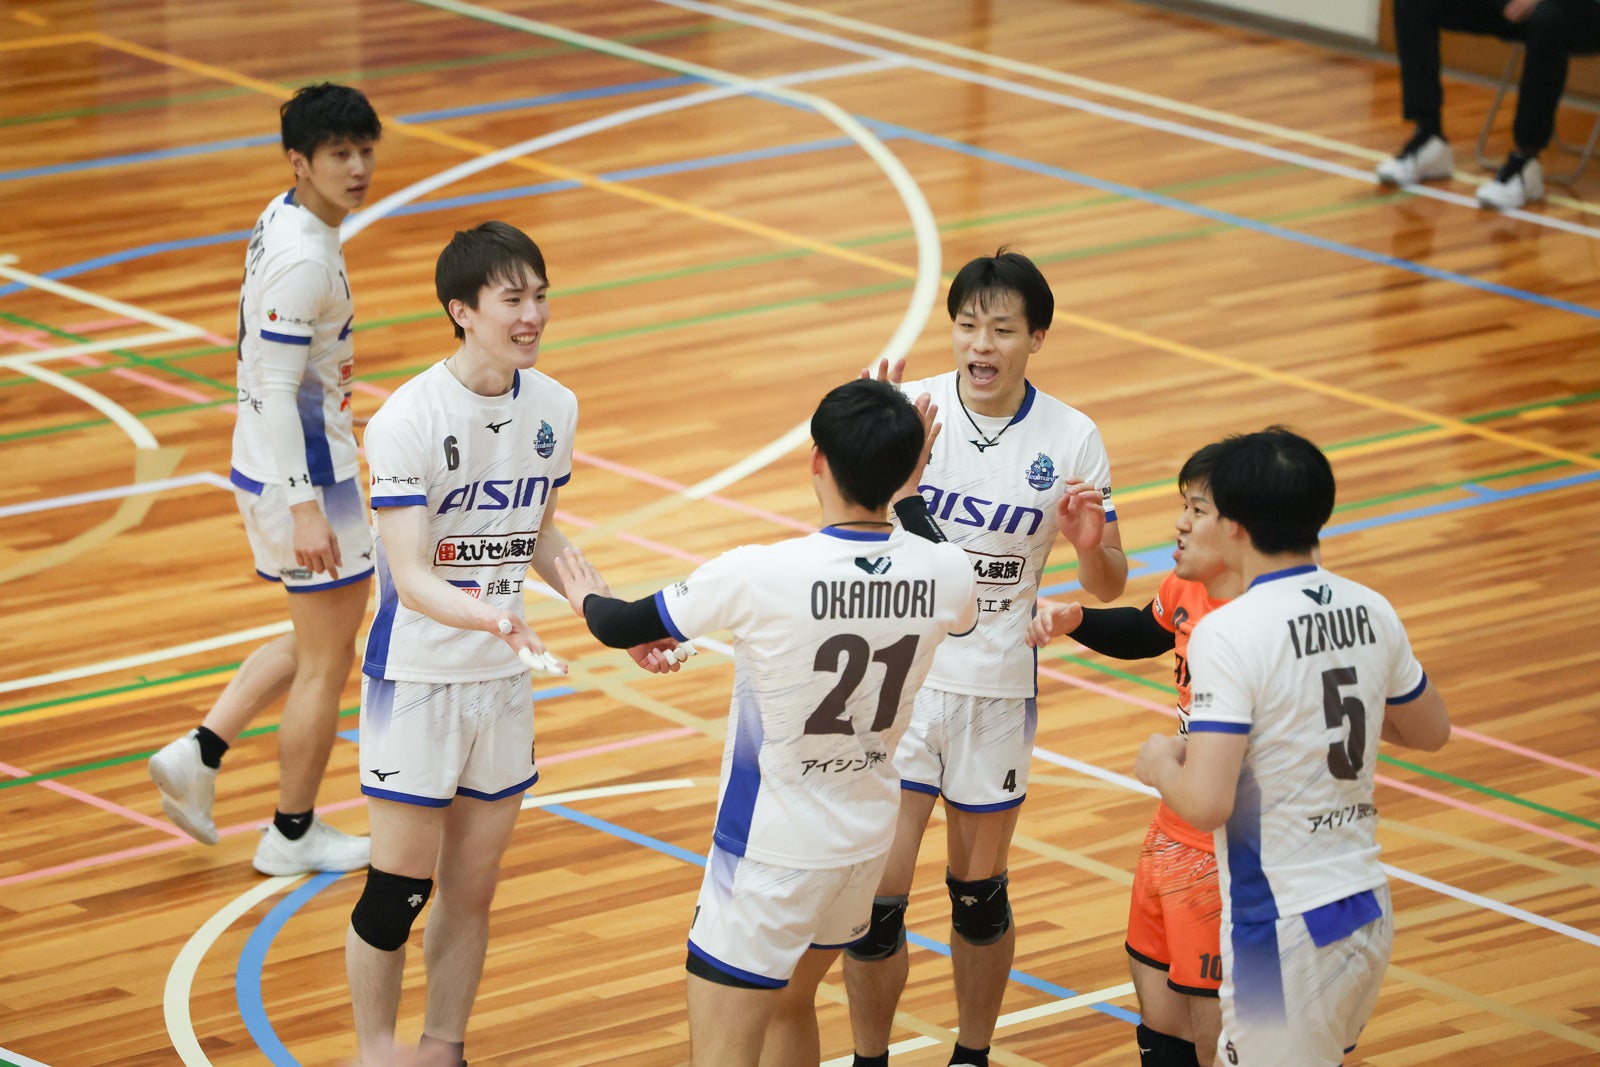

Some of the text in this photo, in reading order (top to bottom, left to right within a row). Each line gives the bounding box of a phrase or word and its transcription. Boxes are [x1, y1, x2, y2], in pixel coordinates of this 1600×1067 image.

[444, 435, 460, 471] 6
[437, 476, 549, 514] AISIN
[456, 539, 537, 561] えびせん家族
[811, 579, 936, 620] OKAMORI
[1287, 605, 1376, 659] IZAWA
[803, 633, 921, 735] 21
[1321, 666, 1366, 781] 5
[1002, 769, 1016, 793] 4
[1199, 953, 1223, 980] 10
